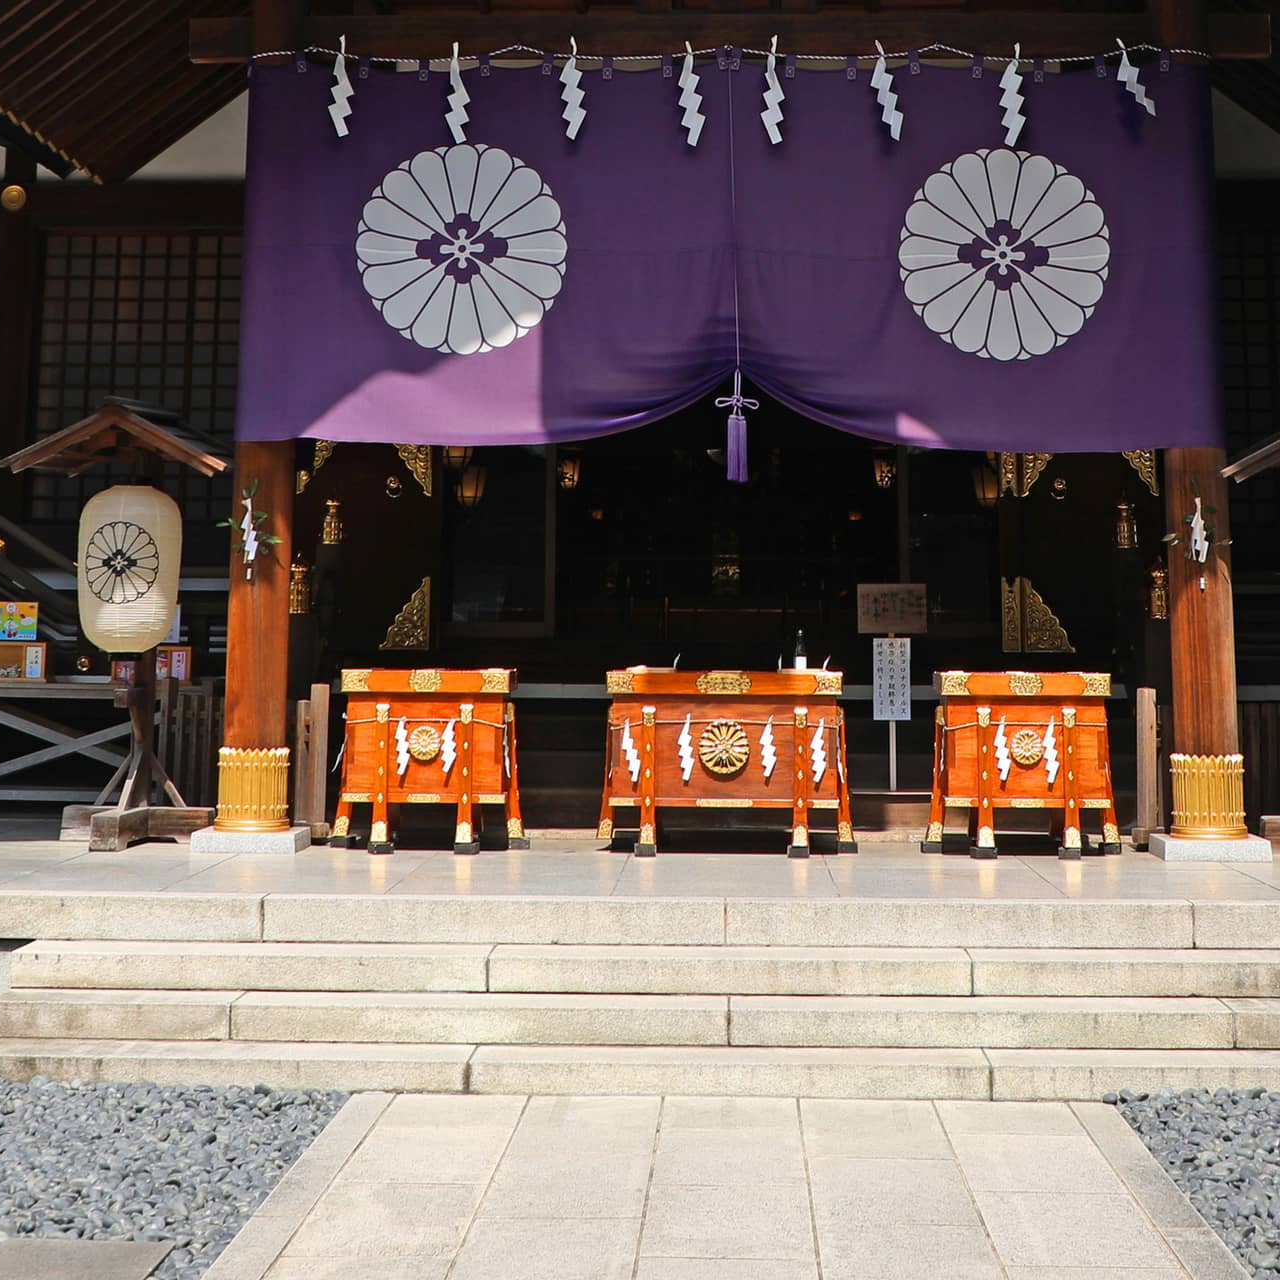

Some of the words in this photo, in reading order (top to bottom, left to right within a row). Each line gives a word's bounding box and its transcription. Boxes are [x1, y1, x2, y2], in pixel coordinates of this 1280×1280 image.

[899, 641, 907, 714] 新型コロナウイルス
